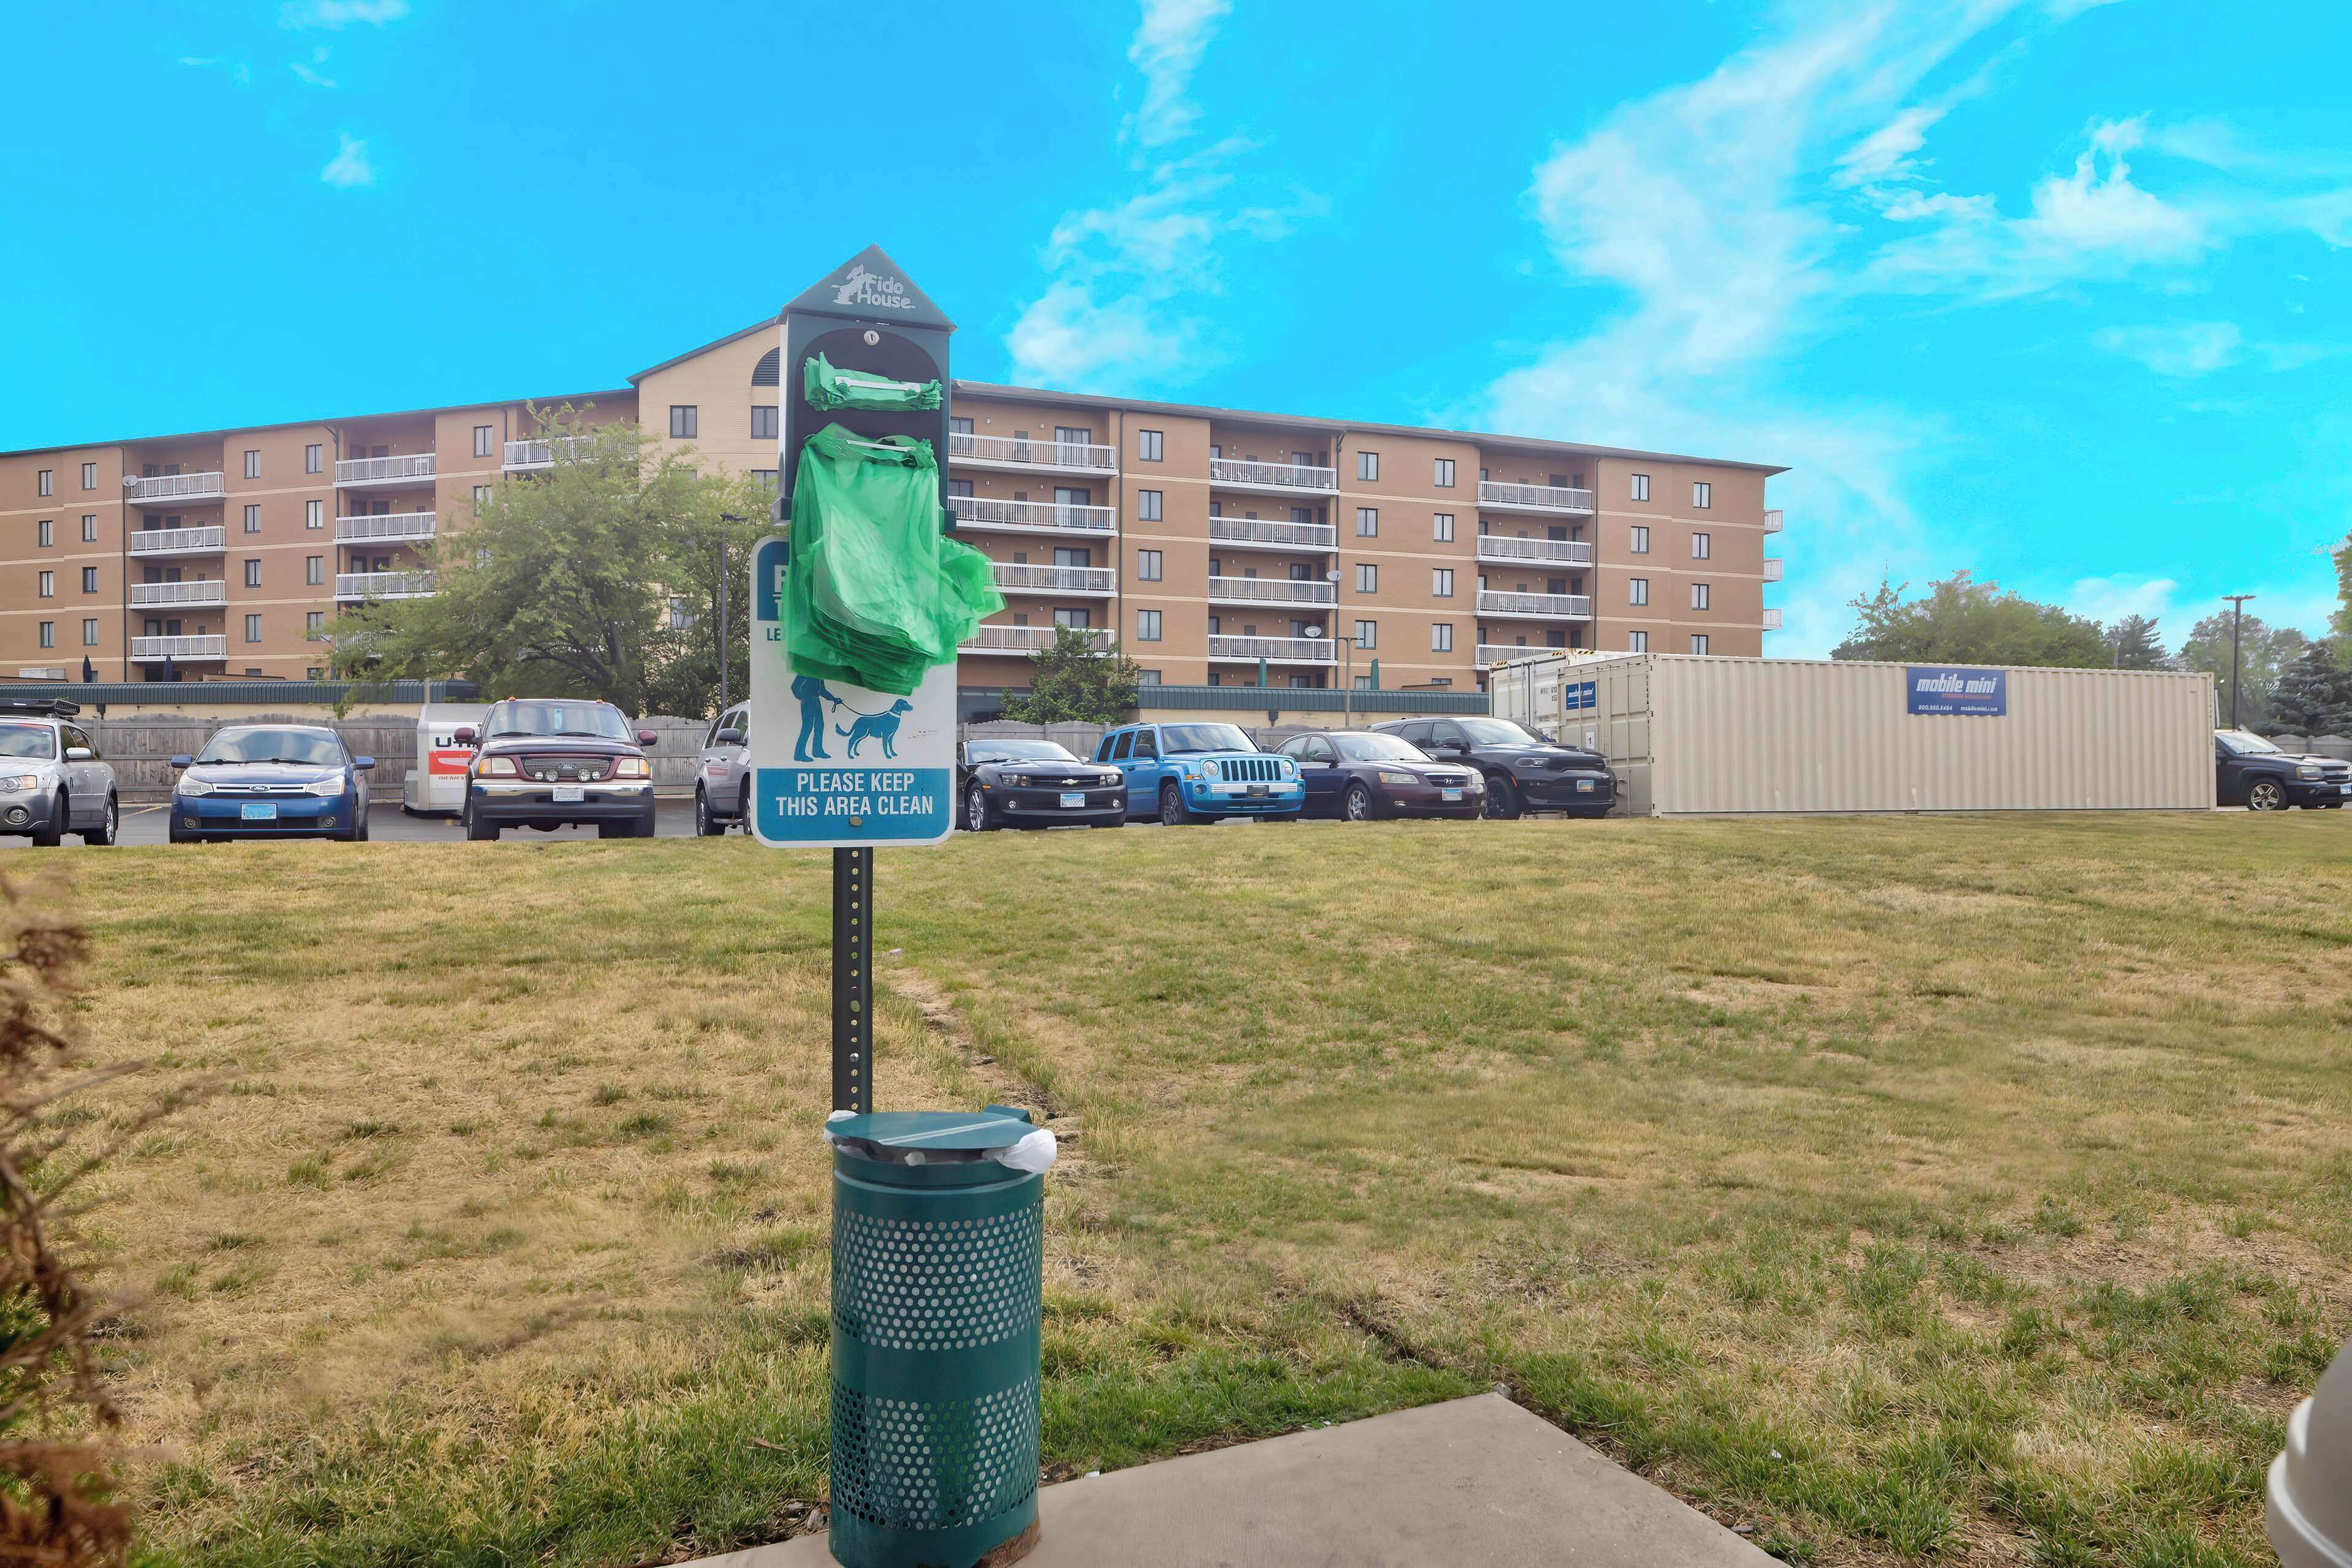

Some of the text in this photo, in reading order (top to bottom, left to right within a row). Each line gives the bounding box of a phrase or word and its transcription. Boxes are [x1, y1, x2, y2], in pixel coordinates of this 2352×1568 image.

[864, 273, 904, 294] Fido
[856, 288, 912, 309] House
[1916, 673, 1997, 693] mobile mini
[797, 772, 915, 792] PLEASE KEEP
[776, 796, 933, 816] THIS AREA CLEAN
